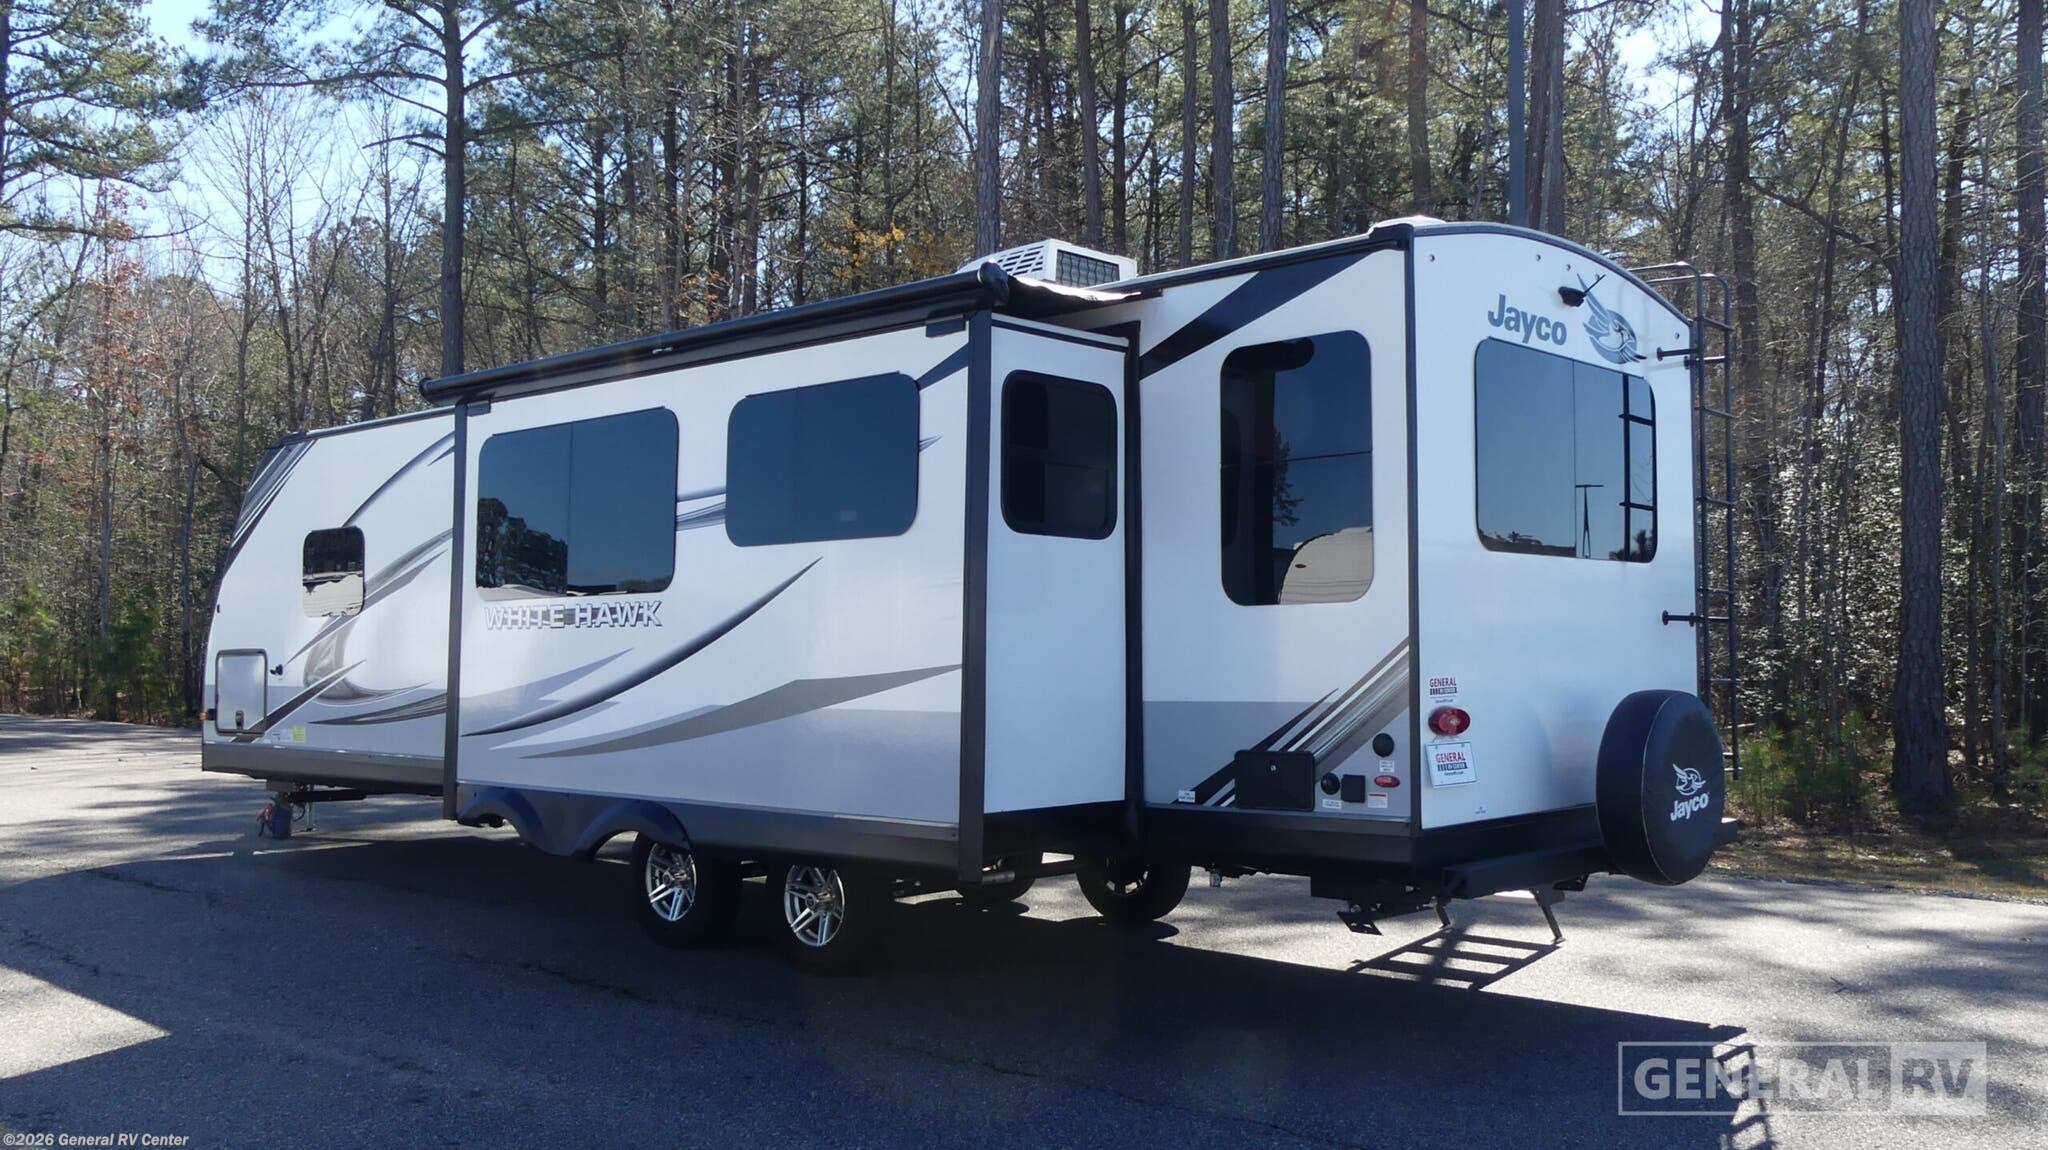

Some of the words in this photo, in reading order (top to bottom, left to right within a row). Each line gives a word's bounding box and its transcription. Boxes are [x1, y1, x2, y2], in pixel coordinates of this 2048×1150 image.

[1487, 293, 1568, 346] Jayco
[484, 604, 566, 631] WHITE
[574, 600, 664, 629] HAWK
[1429, 677, 1457, 688] GENERAL
[1435, 751, 1466, 763] GENERAL
[1670, 793, 1709, 821] Jayco
